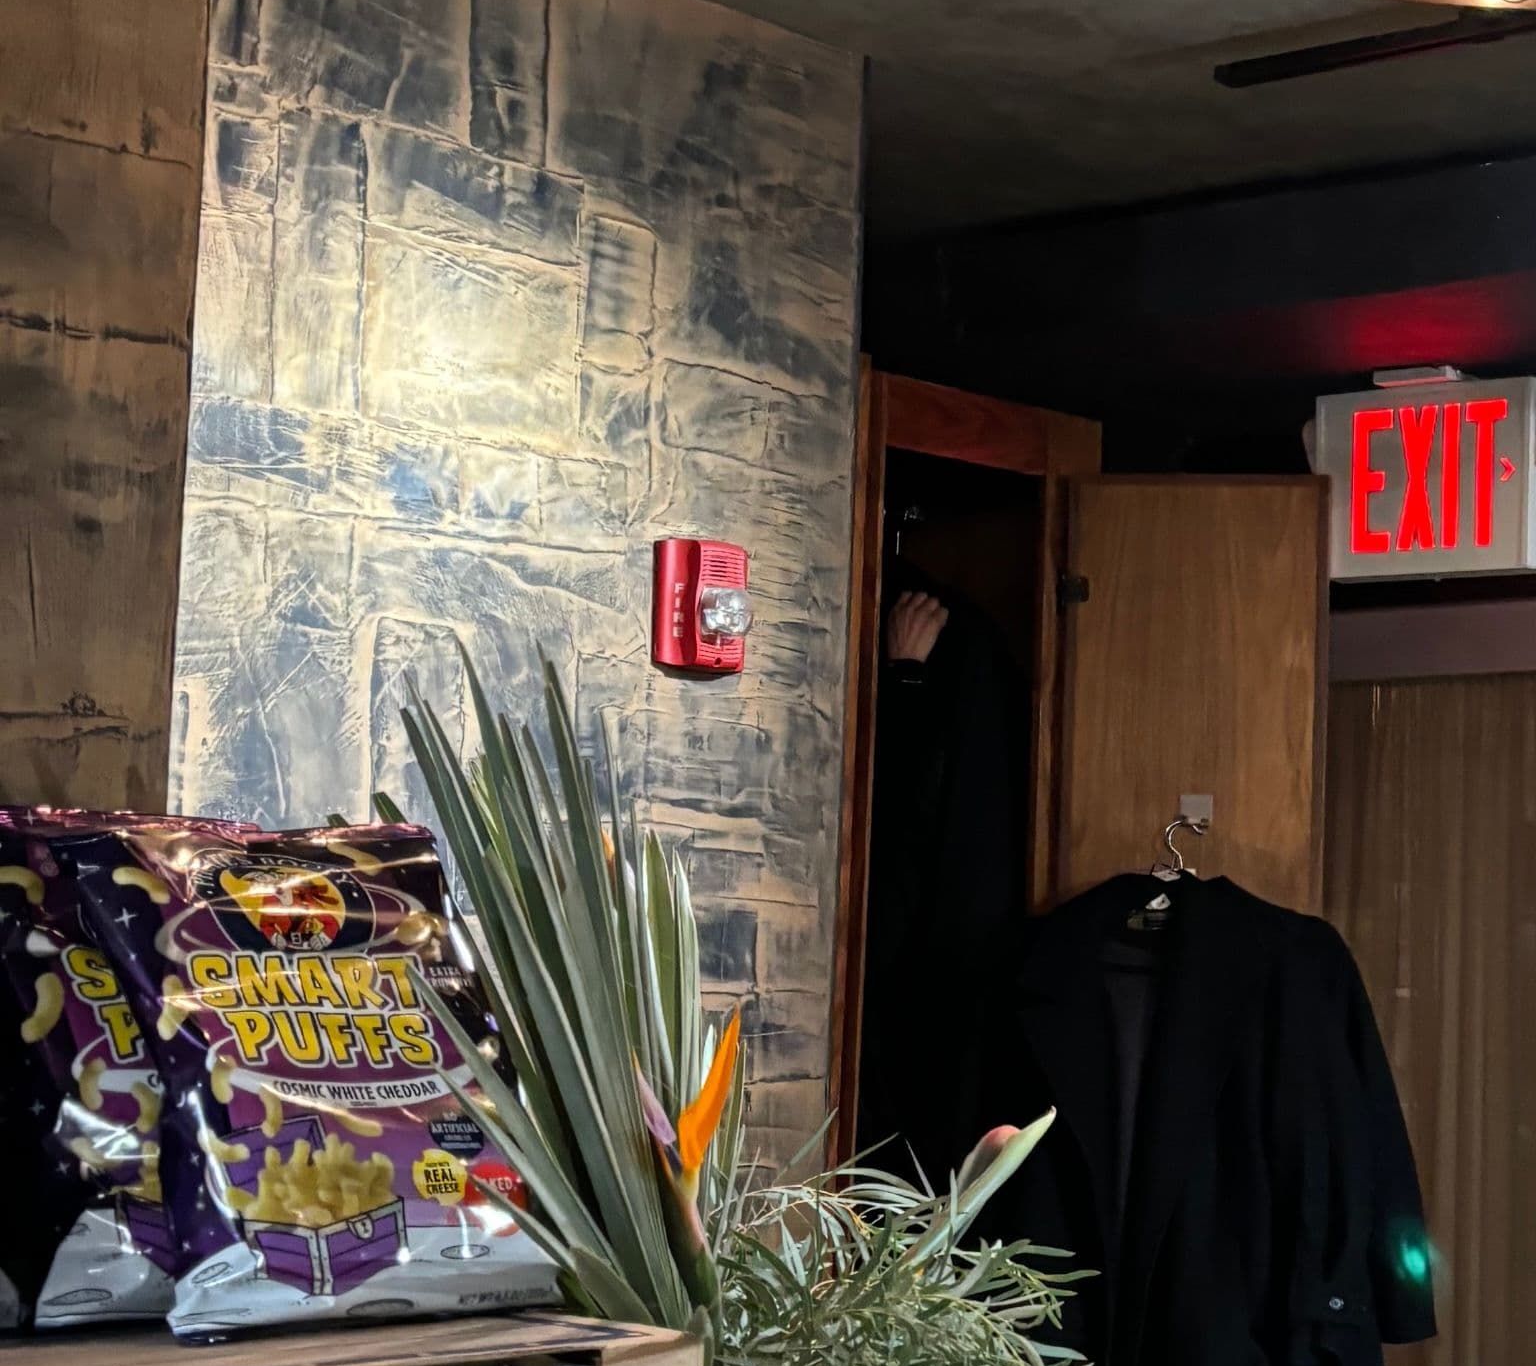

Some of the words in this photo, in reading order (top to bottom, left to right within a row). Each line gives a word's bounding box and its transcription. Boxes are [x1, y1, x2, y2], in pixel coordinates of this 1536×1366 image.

[1350, 398, 1508, 554] EXIT
[672, 582, 685, 638] FIRE
[190, 953, 421, 1010] SMART
[223, 1011, 437, 1066] PUFFS
[273, 1081, 326, 1100] COSMIC
[327, 1084, 375, 1101] WHITE
[378, 1081, 442, 1099] CHEDDAR
[424, 1168, 456, 1183] REAL
[425, 1182, 460, 1196] CHEESE
